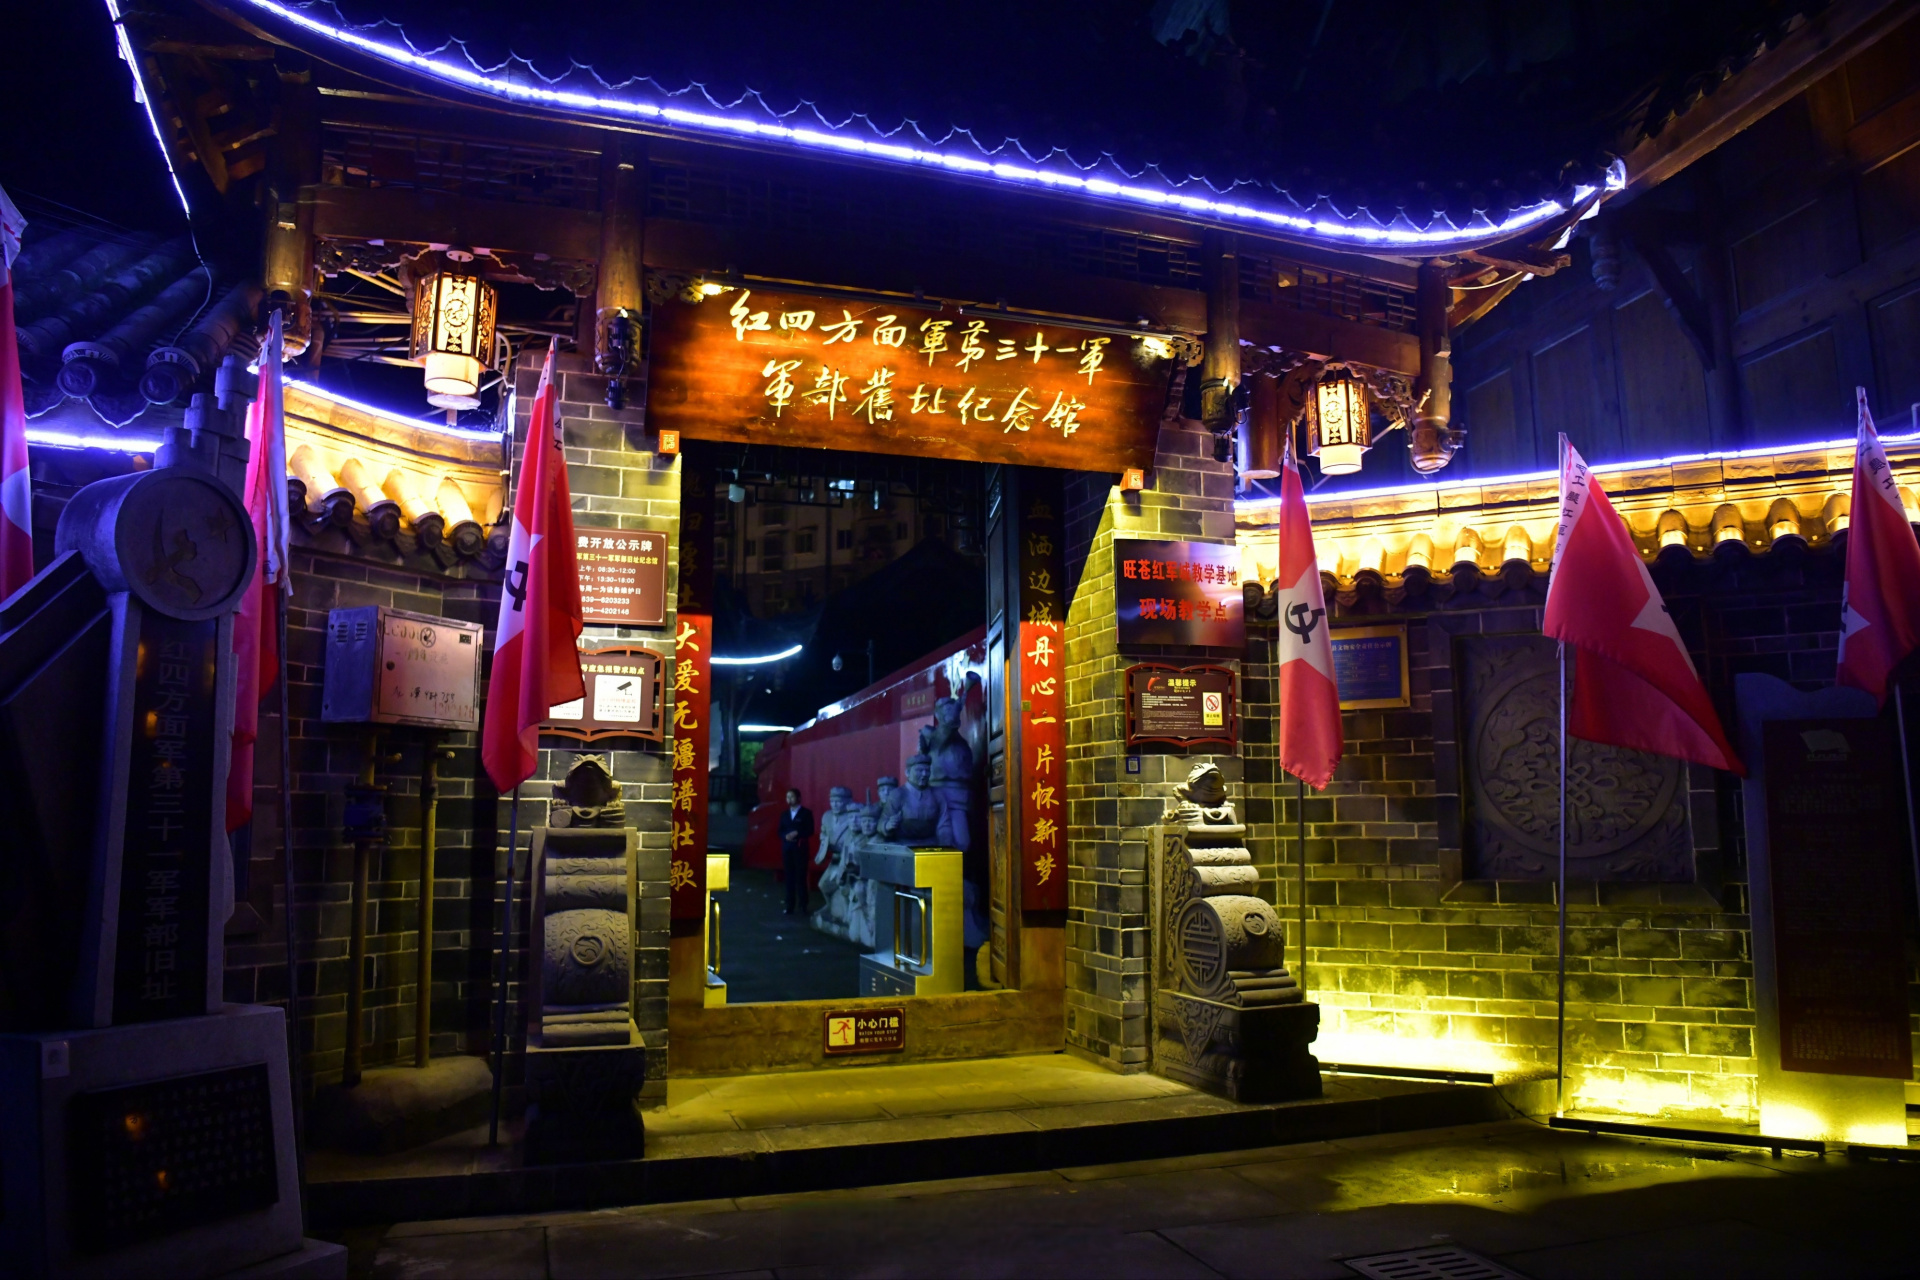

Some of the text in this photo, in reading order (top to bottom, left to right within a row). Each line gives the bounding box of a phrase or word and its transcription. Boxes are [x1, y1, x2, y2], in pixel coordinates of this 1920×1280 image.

[1122, 558, 1238, 587] 旺苍红军城教学基地
[1138, 598, 1228, 623] 现场教学点
[1167, 678, 1197, 688] 温馨提示
[857, 1016, 900, 1030] 小心门槛
